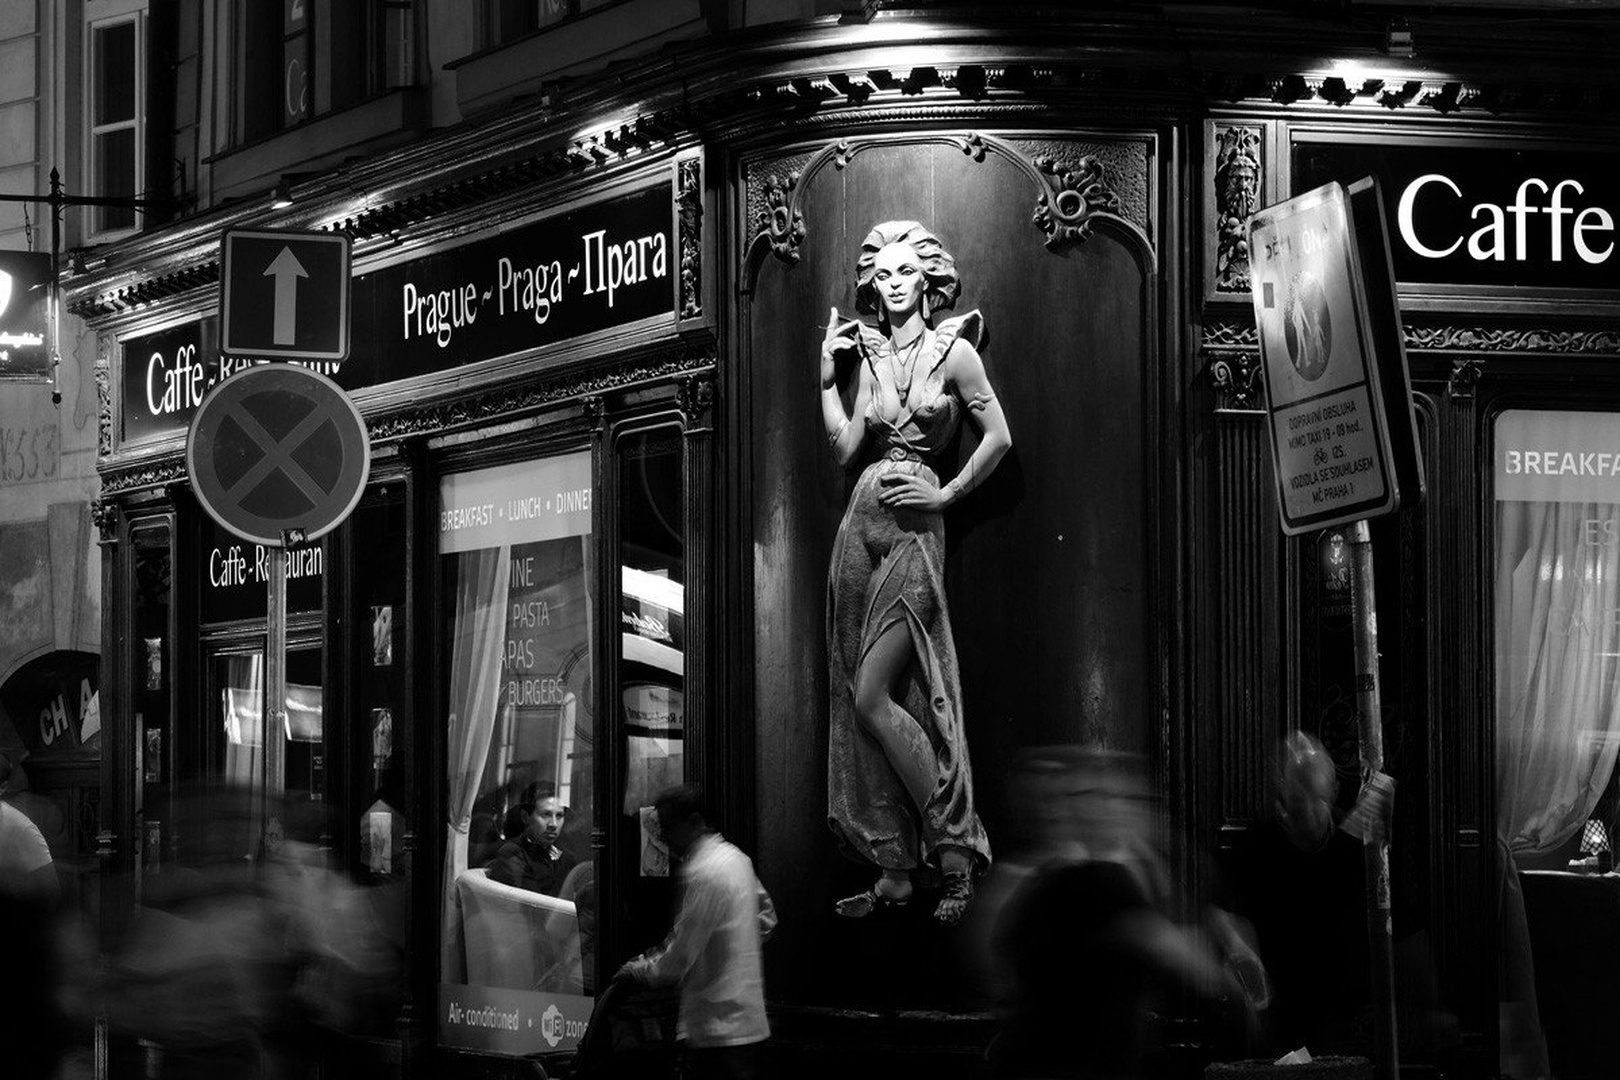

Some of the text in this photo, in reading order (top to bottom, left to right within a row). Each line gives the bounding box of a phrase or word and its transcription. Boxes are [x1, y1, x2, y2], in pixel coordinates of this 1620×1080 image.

[1397, 173, 1615, 264] Caffe
[403, 229, 667, 348] Prague Praga Прага
[147, 343, 204, 415] Caffe
[1324, 483, 1349, 499] PRAHA
[440, 504, 494, 532] BREAKFAST
[508, 497, 541, 521] LUNCH
[210, 545, 247, 588] Caffe
[511, 557, 535, 588] INE
[513, 601, 550, 628] PASTA
[500, 638, 534, 669] APAS
[508, 678, 564, 706] BURGERS
